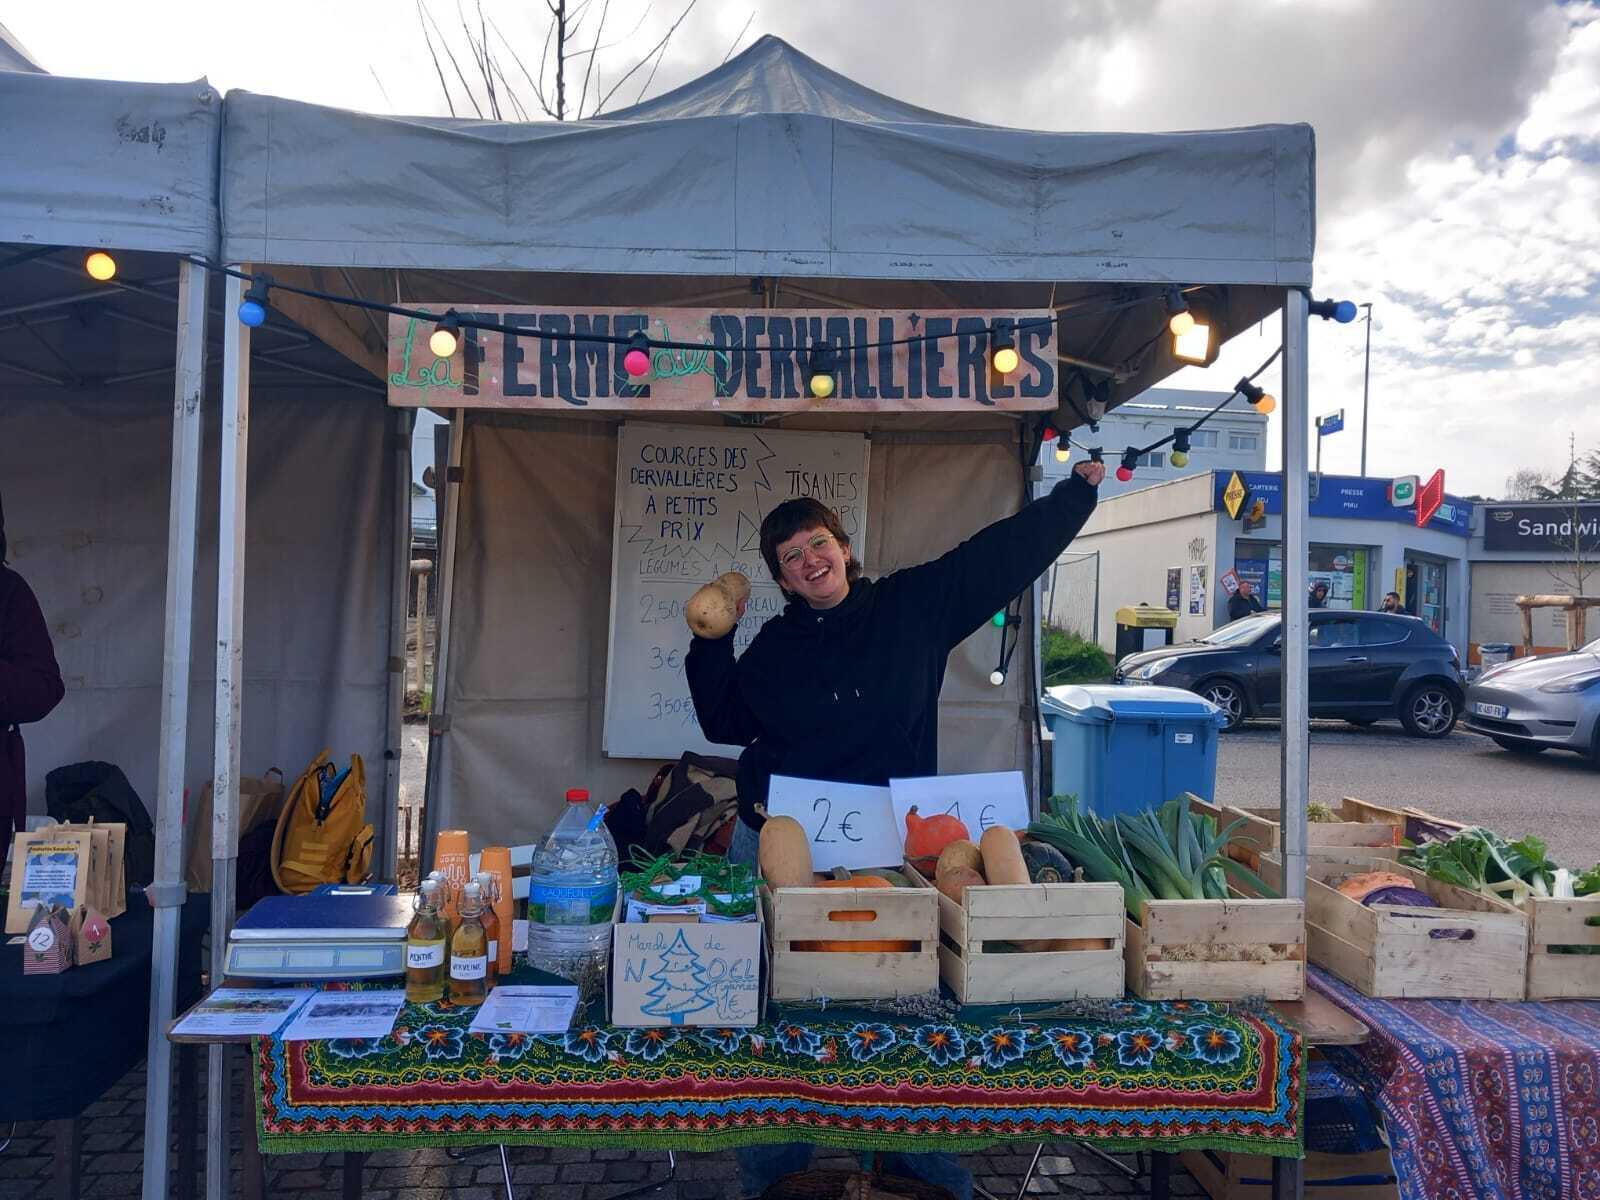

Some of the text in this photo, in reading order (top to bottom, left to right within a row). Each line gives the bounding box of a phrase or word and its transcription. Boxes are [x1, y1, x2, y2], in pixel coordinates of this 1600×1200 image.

[390, 308, 463, 389] La
[457, 312, 650, 405] FERME
[640, 444, 748, 469] COURGES DES
[665, 491, 719, 516] PETITS
[1340, 488, 1364, 497] PRESSE
[1517, 518, 1600, 537] Sandwi
[813, 797, 863, 843] 2€
